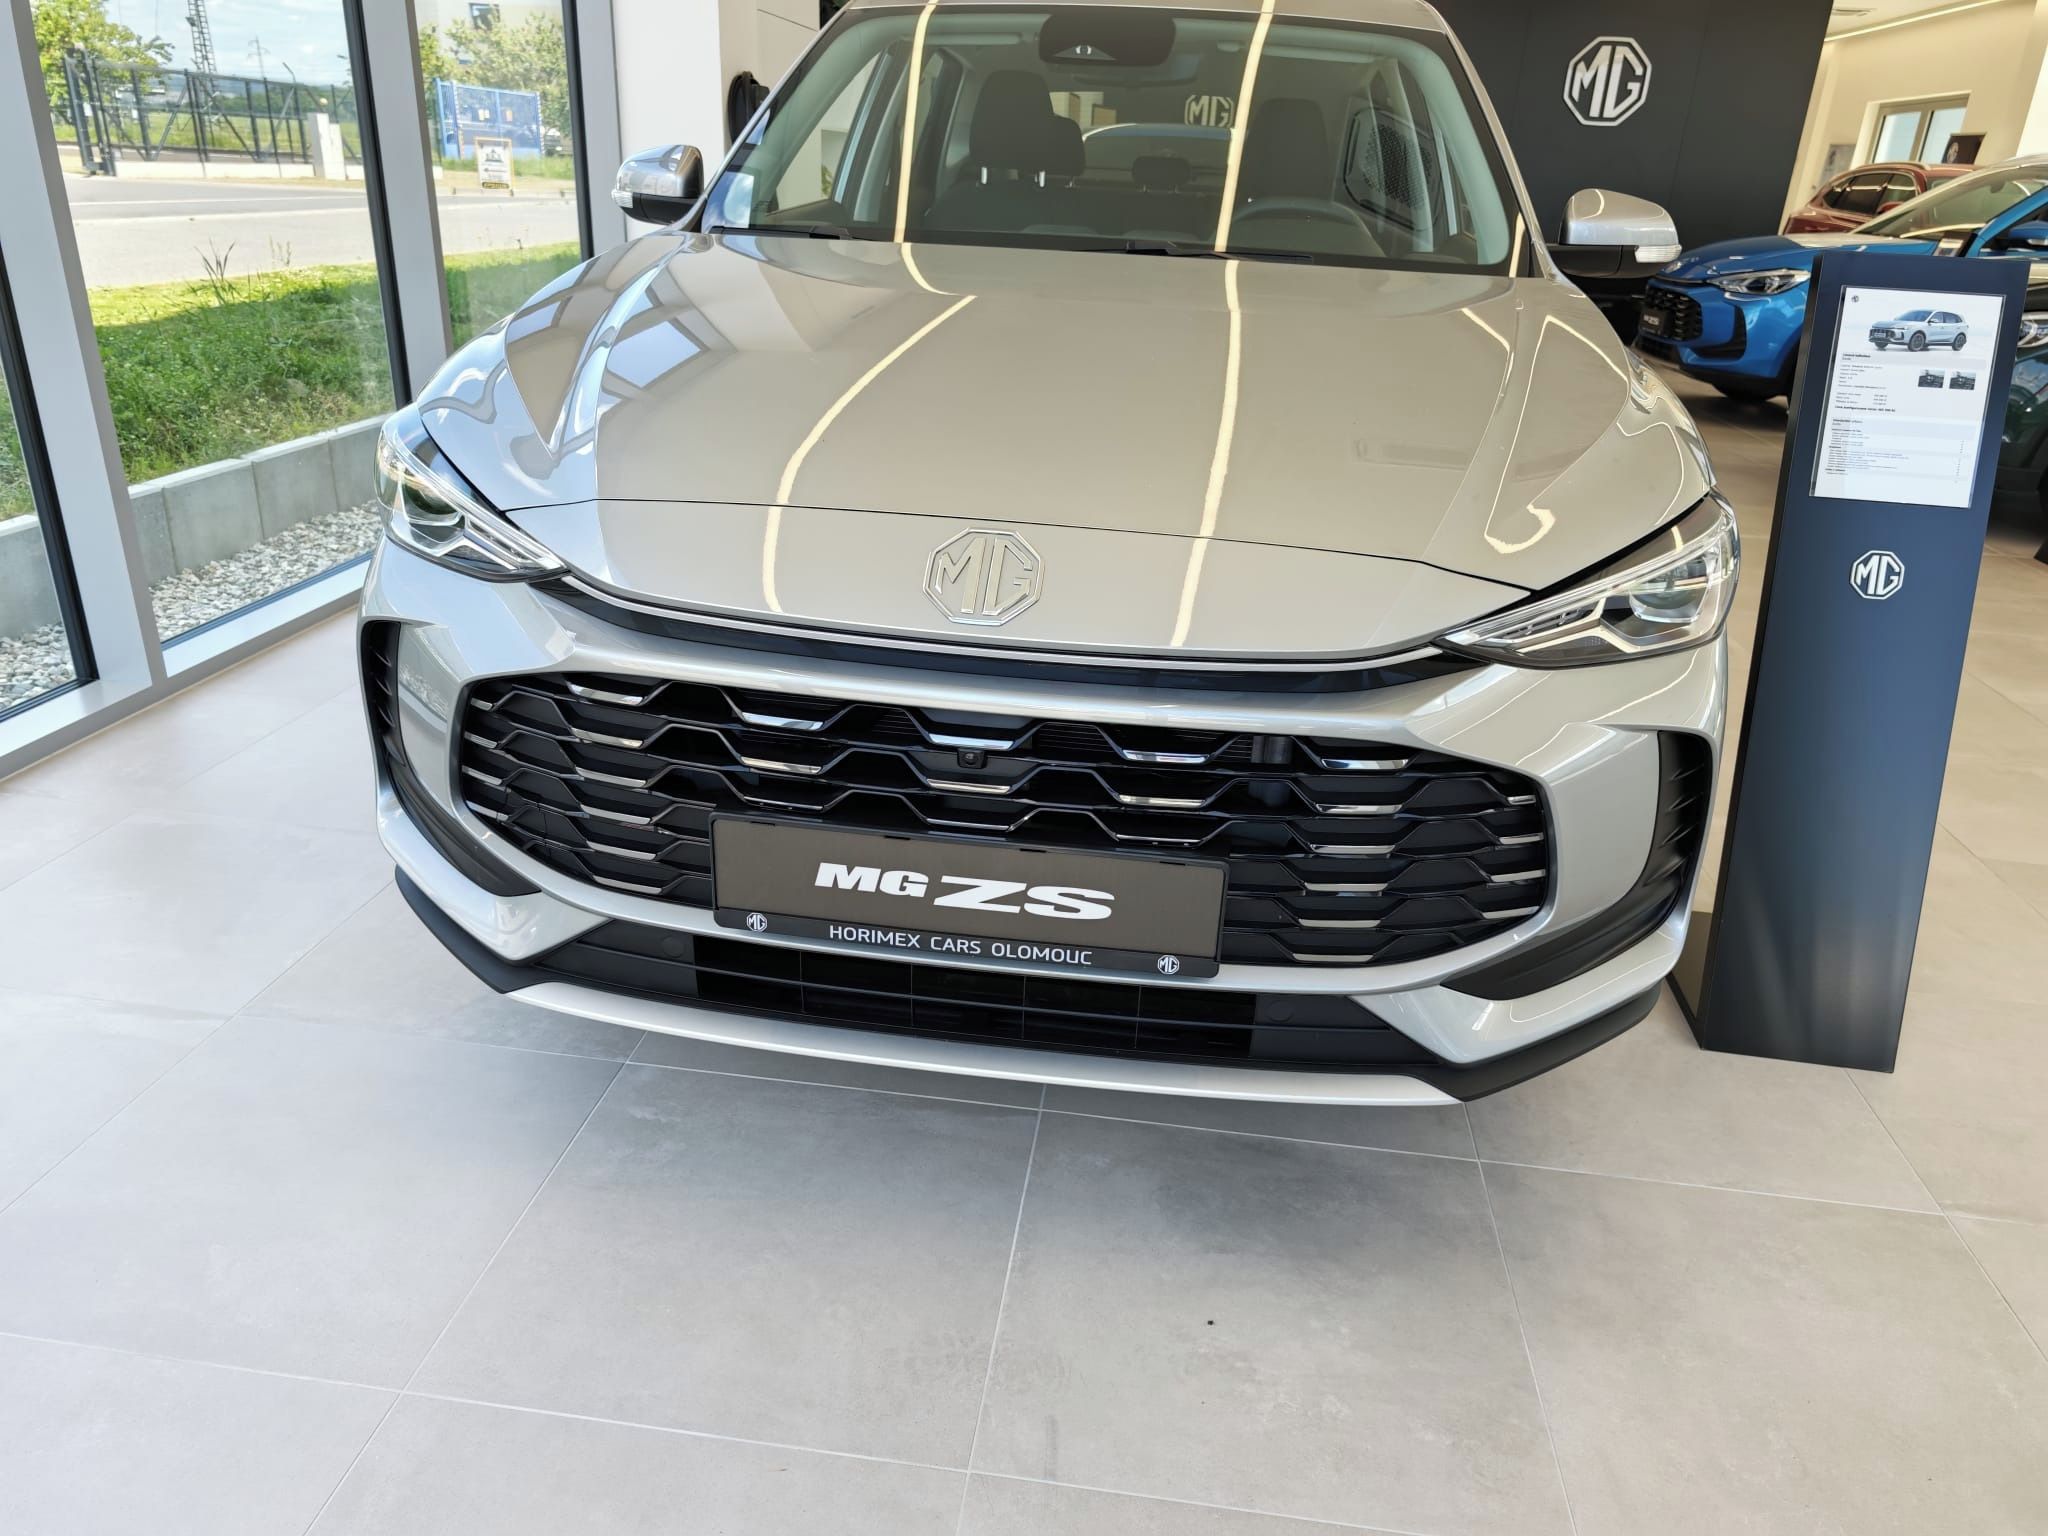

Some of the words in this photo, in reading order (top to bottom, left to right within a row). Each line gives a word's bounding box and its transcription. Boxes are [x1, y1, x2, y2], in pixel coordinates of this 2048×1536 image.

[1571, 44, 1643, 118] MG
[1189, 95, 1230, 127] MG
[934, 536, 1034, 616] MG
[1855, 554, 1901, 596] MG
[814, 862, 929, 898] MG
[933, 875, 1115, 920] ZS
[748, 914, 766, 930] MG
[829, 925, 921, 949] HORIMEX
[930, 936, 981, 954] CARS
[991, 942, 1092, 965] OLOMOUC
[1159, 956, 1178, 973] MG
